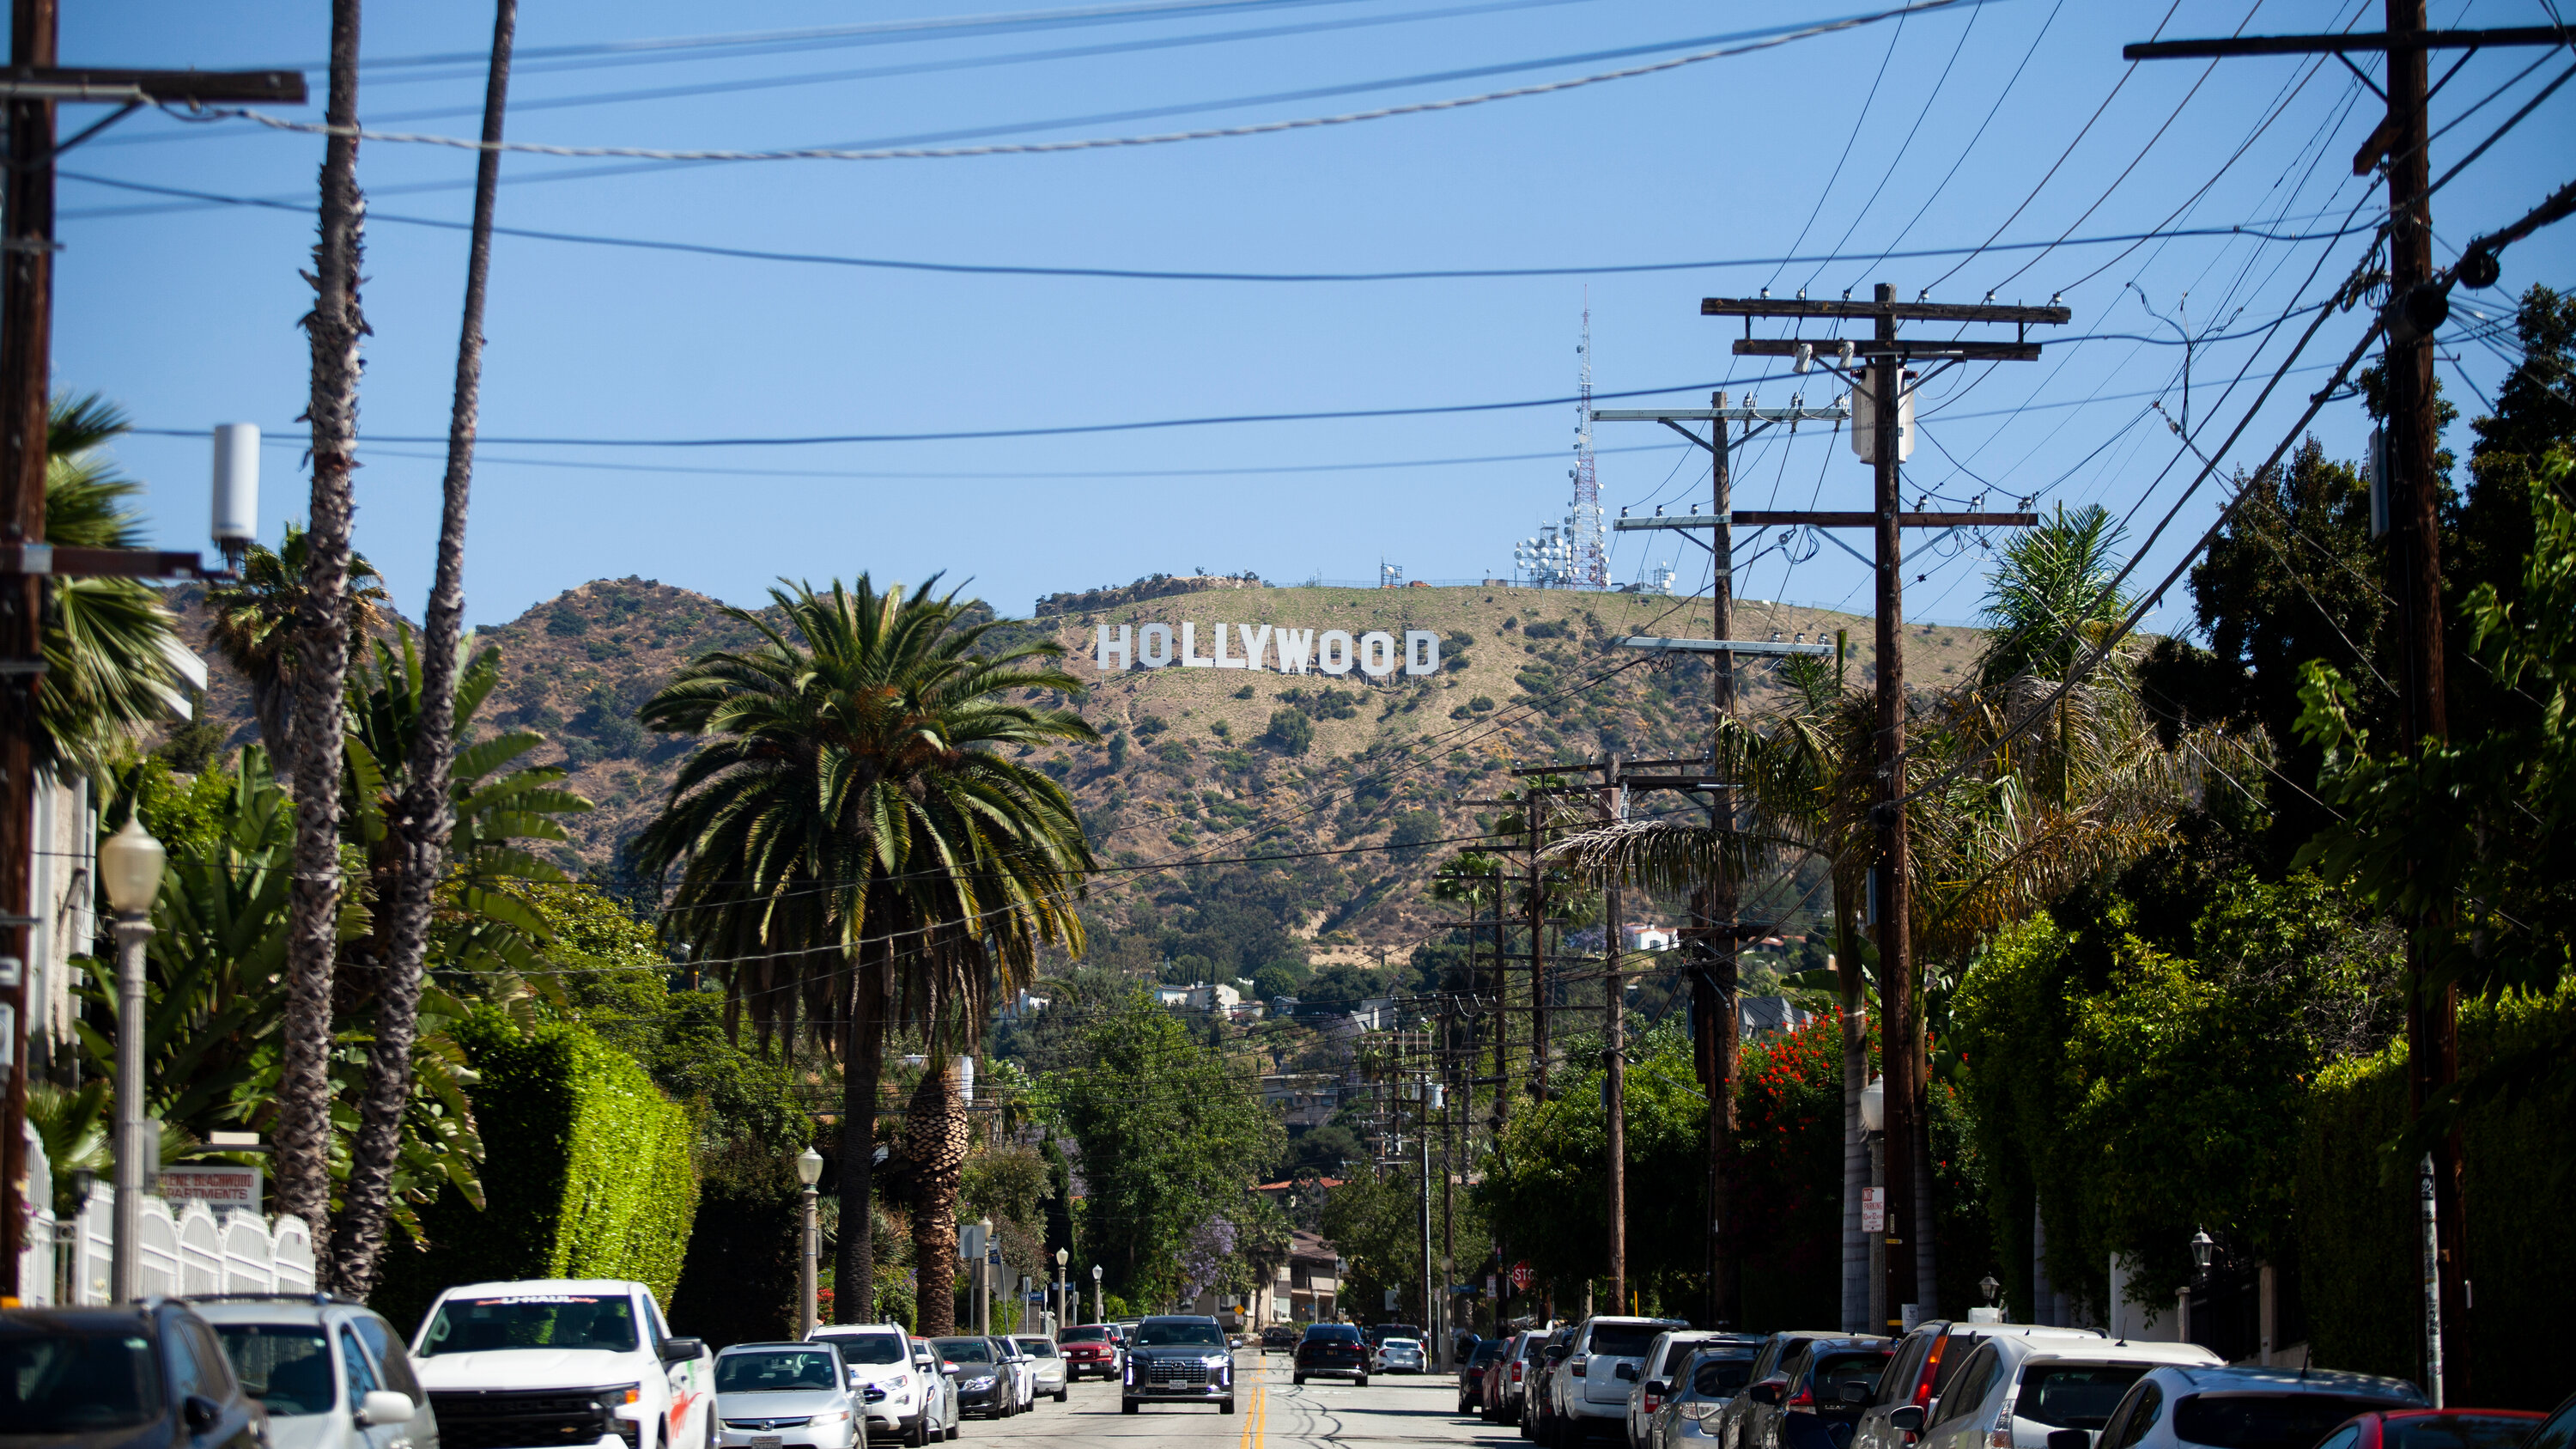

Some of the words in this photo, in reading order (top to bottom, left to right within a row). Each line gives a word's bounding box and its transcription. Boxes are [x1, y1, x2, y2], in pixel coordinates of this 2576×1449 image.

[1097, 622, 1439, 676] HOLLYWOOD
[194, 1173, 254, 1187] BEACHWOOD
[163, 1188, 248, 1199] PARTMENTS
[1864, 1190, 1872, 1200] NO
[1864, 1202, 1882, 1211] PARKING
